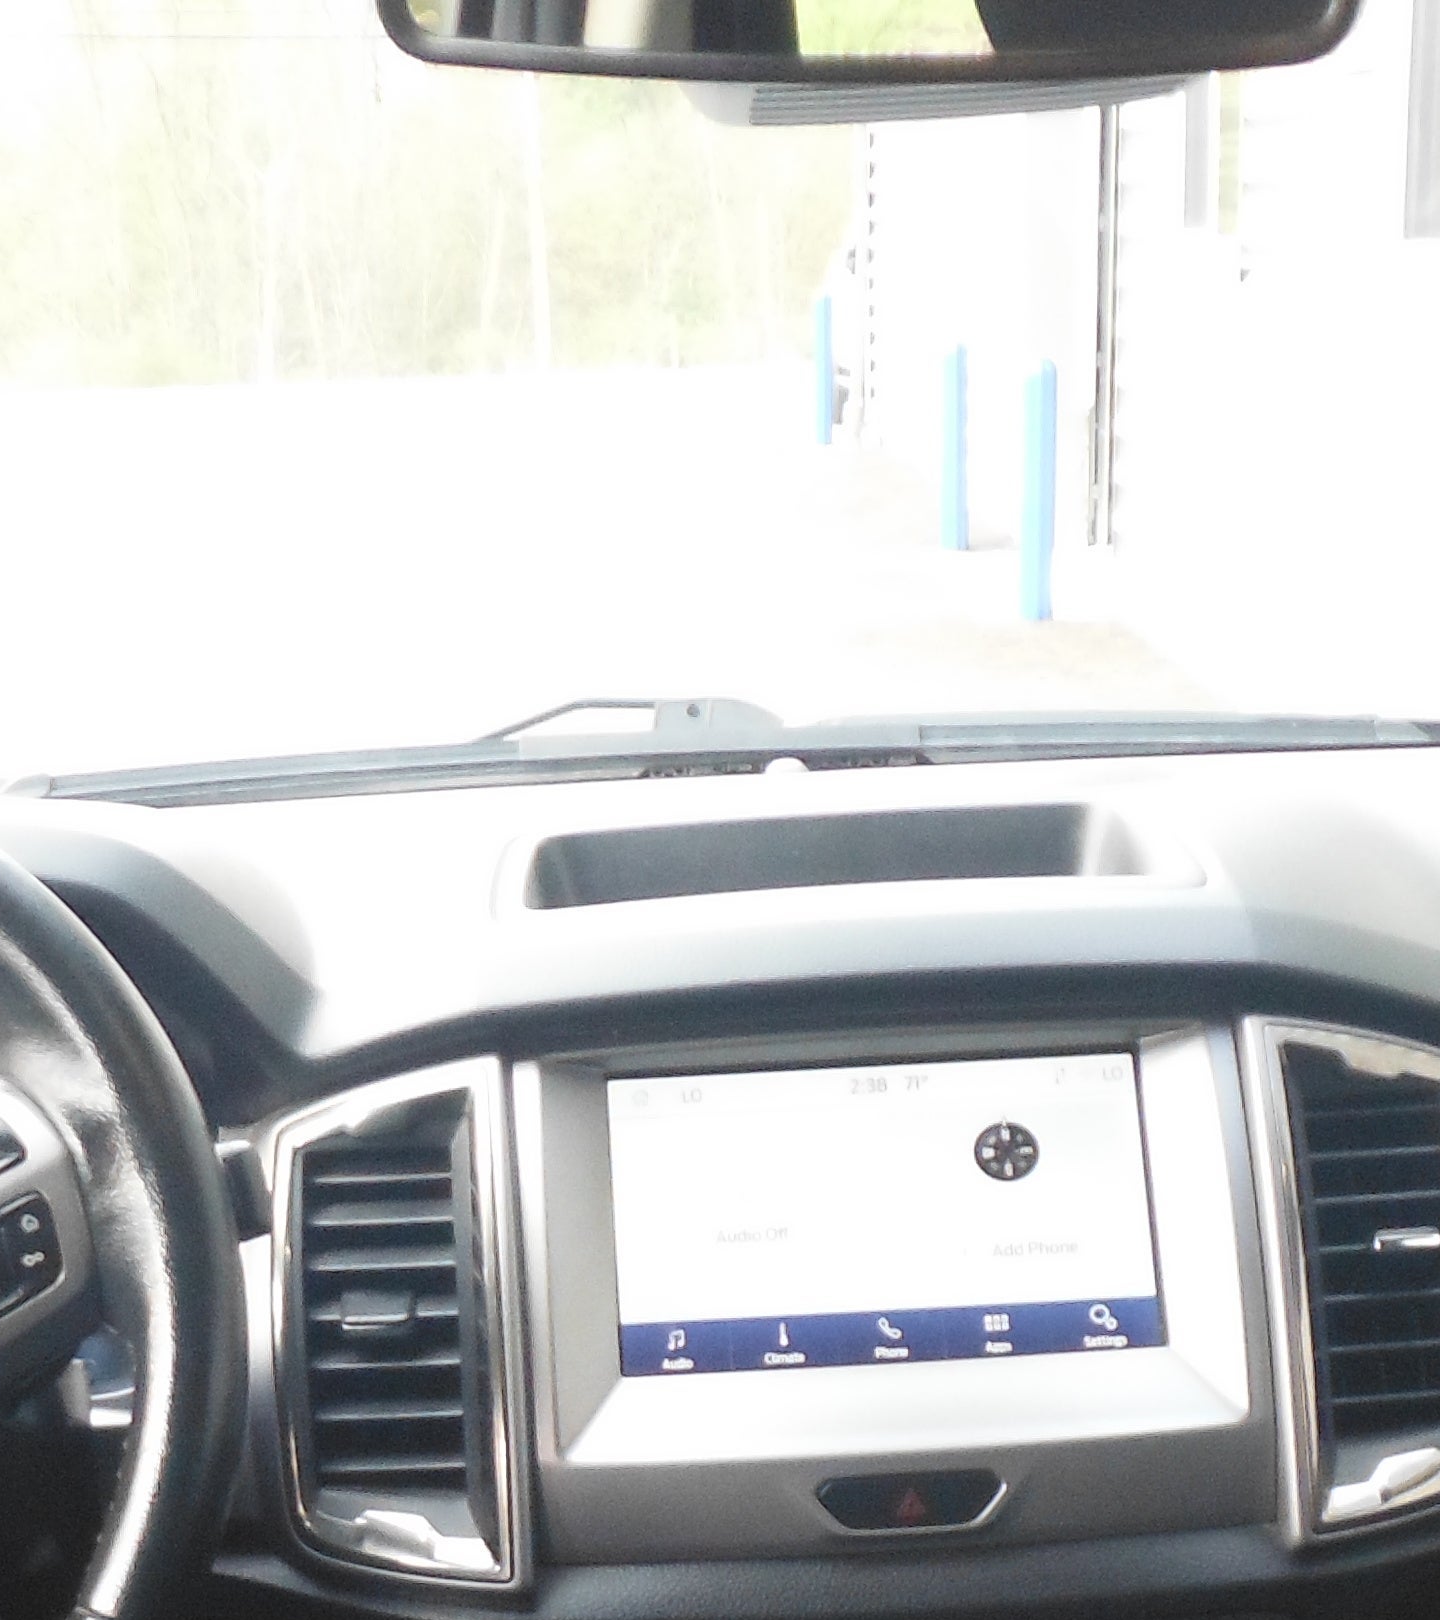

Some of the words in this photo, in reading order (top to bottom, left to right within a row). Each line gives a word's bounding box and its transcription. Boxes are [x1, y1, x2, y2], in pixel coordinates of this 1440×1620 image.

[850, 1077, 888, 1095] 2:38
[715, 1229, 762, 1245] Audio
[765, 1227, 790, 1241] Off
[991, 1243, 1024, 1258] Add
[1027, 1240, 1080, 1256] Phone
[1082, 1335, 1129, 1349] Settings
[662, 1357, 695, 1371] Audio
